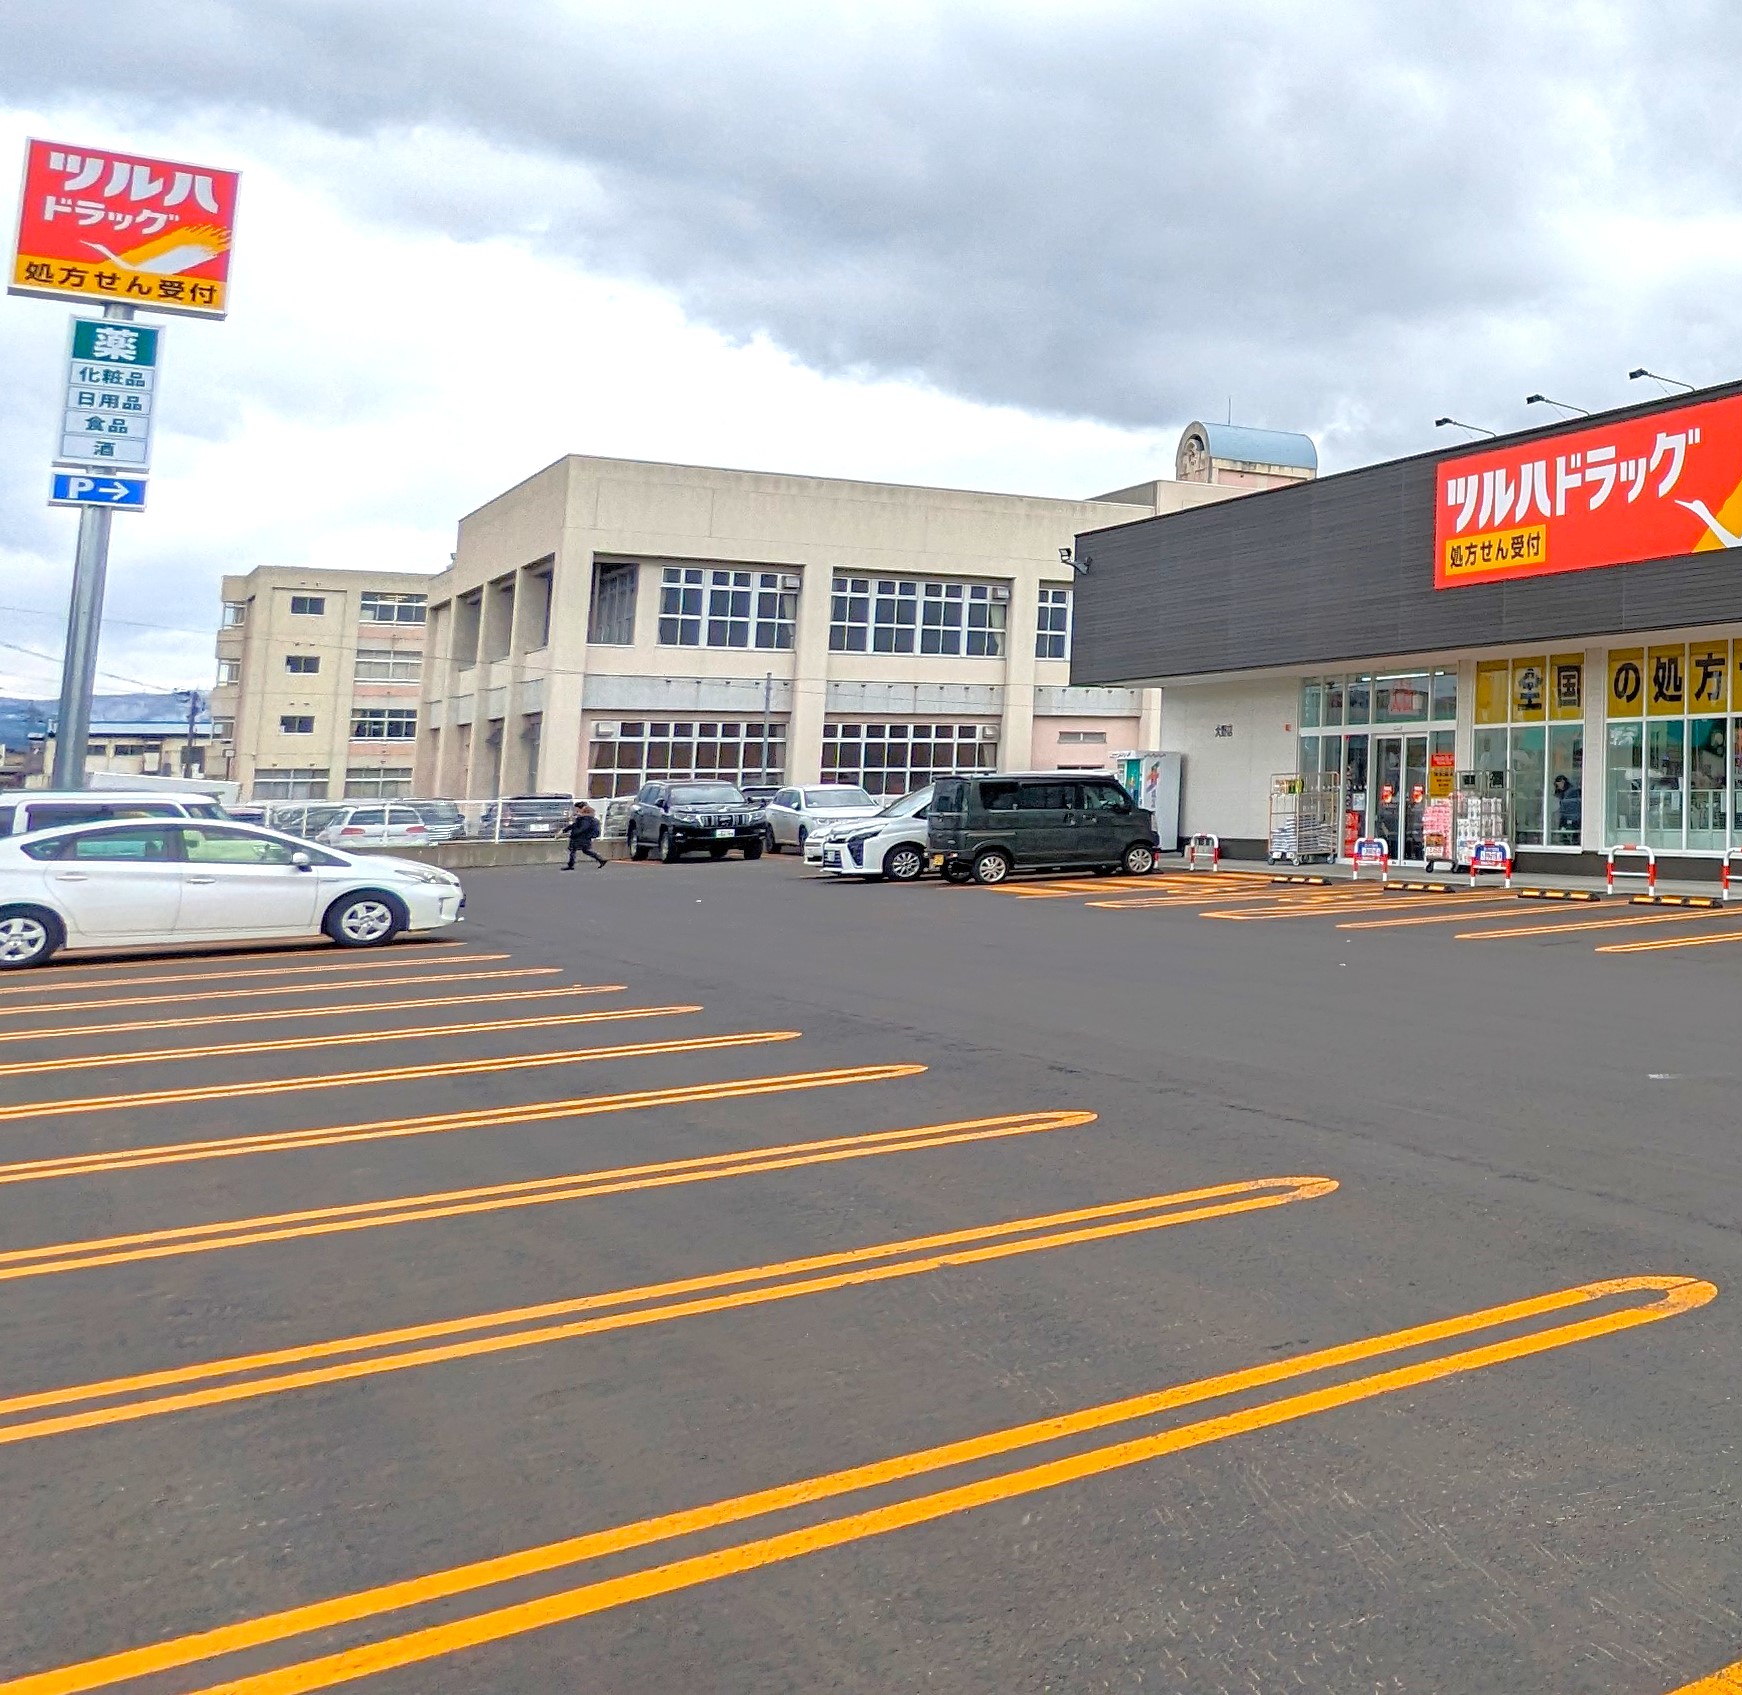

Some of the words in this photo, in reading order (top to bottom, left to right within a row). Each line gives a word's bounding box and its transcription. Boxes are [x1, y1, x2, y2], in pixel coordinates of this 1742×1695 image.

[49, 151, 219, 214] ツルハ
[44, 195, 181, 234] ドラッグ
[25, 261, 218, 304] 処方せん受付
[93, 327, 139, 361] 薬
[79, 367, 146, 388] 化粧品
[78, 392, 143, 411] 日用品
[85, 415, 129, 434] 食品
[93, 441, 116, 458] 酒
[67, 477, 94, 499] P
[1447, 428, 1701, 533] ツルハドラッグ
[1450, 531, 1541, 569] 処方せん受付
